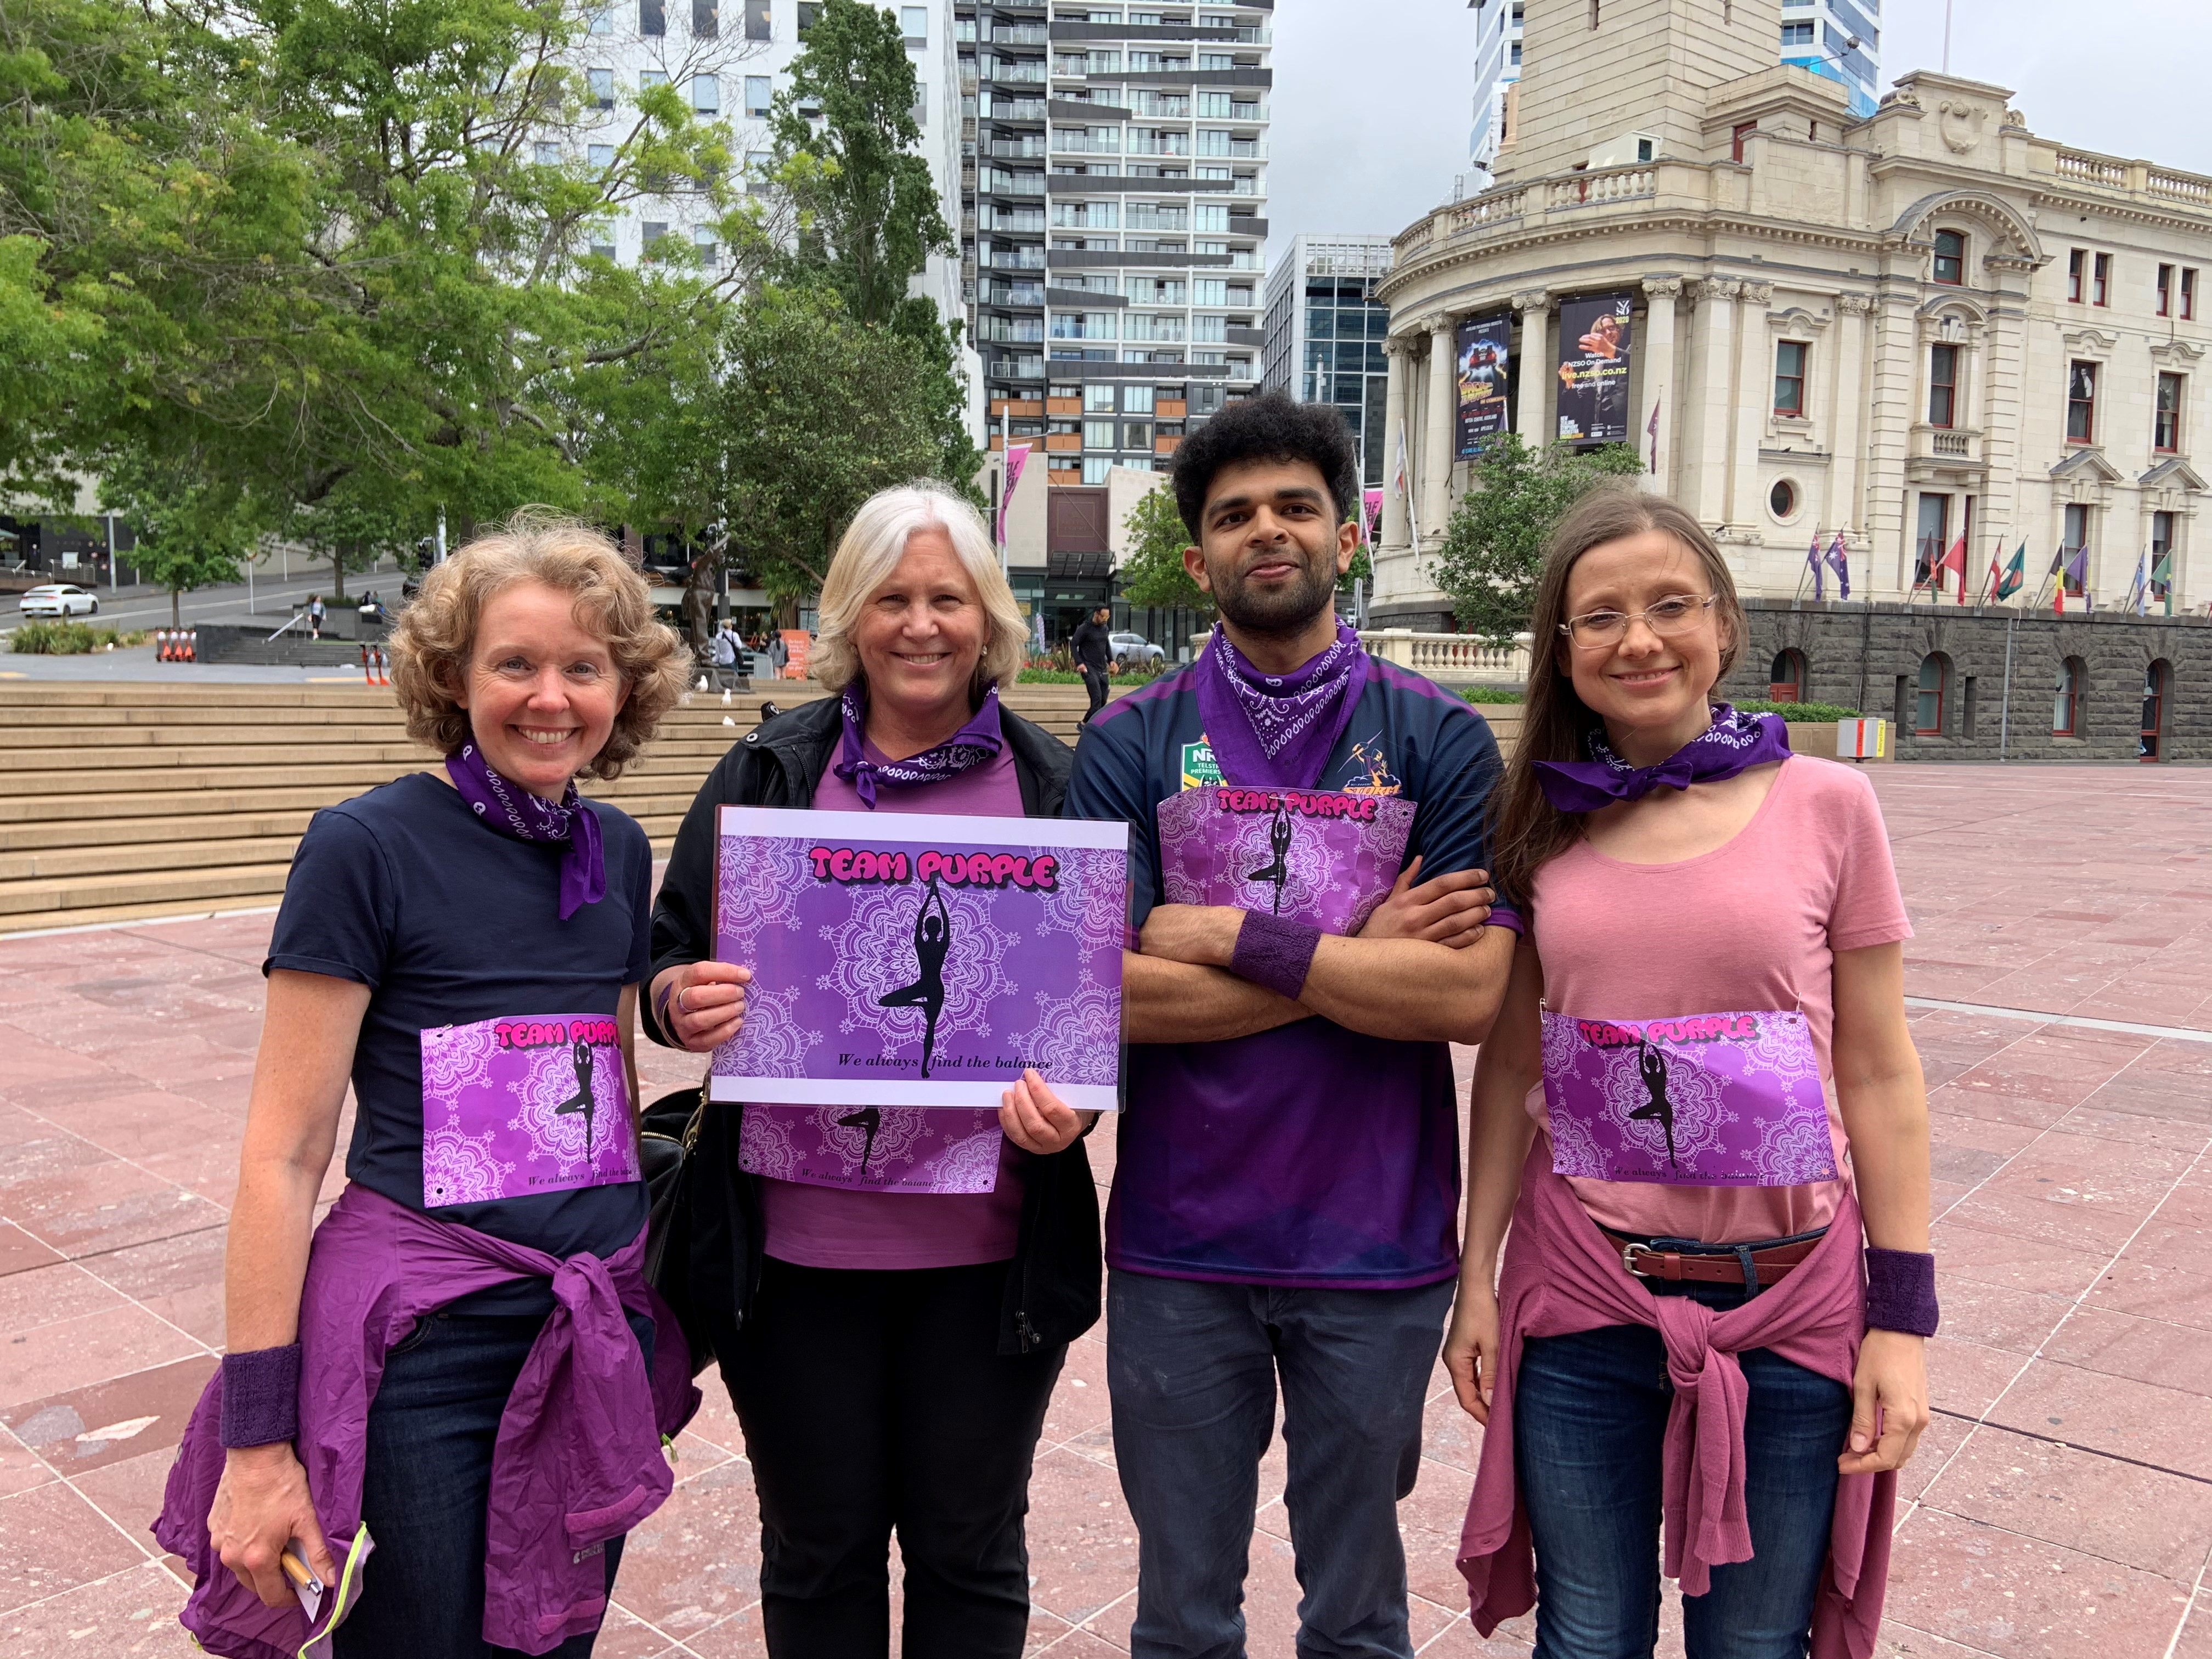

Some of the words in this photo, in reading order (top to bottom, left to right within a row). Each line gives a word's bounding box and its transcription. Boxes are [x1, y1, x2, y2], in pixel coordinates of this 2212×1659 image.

[1562, 368, 1627, 379] live.nzso.co.nz
[1193, 748, 1217, 763] NR
[1216, 789, 1278, 811] TEAM
[1285, 792, 1375, 820] PURPLE
[809, 846, 908, 881] TEAM
[917, 850, 1057, 887] PURPLE
[494, 1022, 565, 1047] TEAM
[569, 1020, 620, 1045] PURPL
[1579, 1020, 1641, 1046] TEAM
[1647, 1015, 1756, 1042] PURPLE
[838, 1053, 861, 1066] We
[866, 1054, 918, 1070] always
[928, 1055, 962, 1070] find
[967, 1056, 990, 1068] the
[995, 1056, 1053, 1069] balance
[529, 1176, 545, 1186] We
[548, 1173, 584, 1183] always
[610, 1167, 619, 1176] the
[802, 1168, 816, 1178] We
[819, 1172, 852, 1184] always
[858, 1176, 880, 1186] find
[884, 1177, 899, 1186] the
[1615, 1166, 1629, 1175] We
[1632, 1168, 1667, 1179] always
[1674, 1170, 1696, 1180] find
[1700, 1171, 1717, 1180] the
[1720, 1170, 1765, 1180] balance
